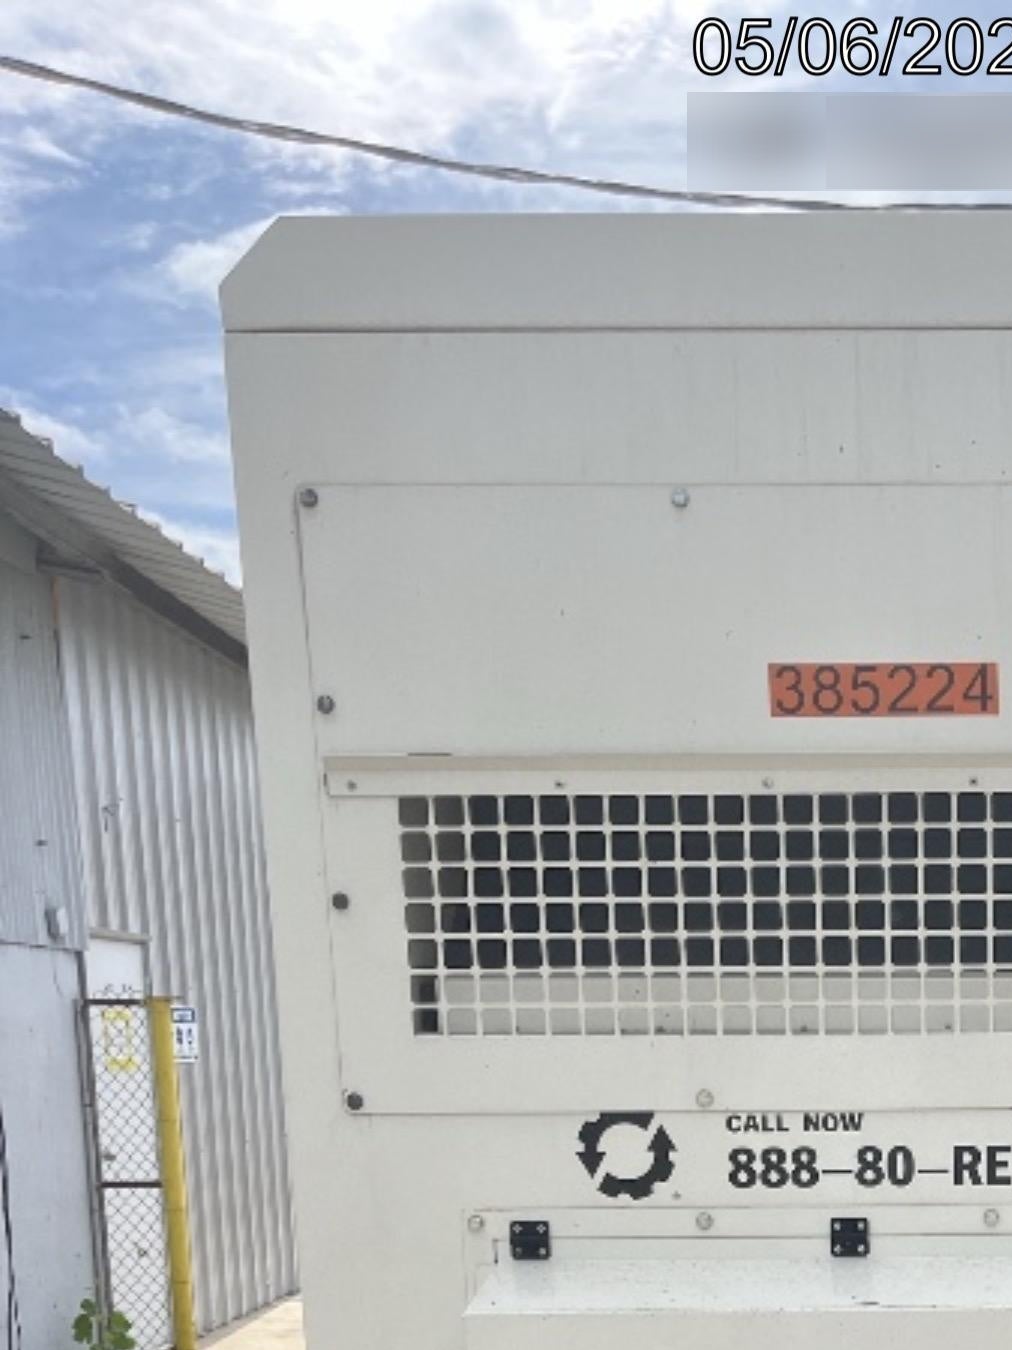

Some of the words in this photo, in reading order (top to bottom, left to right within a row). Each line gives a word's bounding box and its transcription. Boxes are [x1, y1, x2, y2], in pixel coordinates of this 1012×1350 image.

[775, 663, 993, 714] 385224
[726, 1115, 789, 1132] CALL
[803, 1112, 864, 1132] NOW
